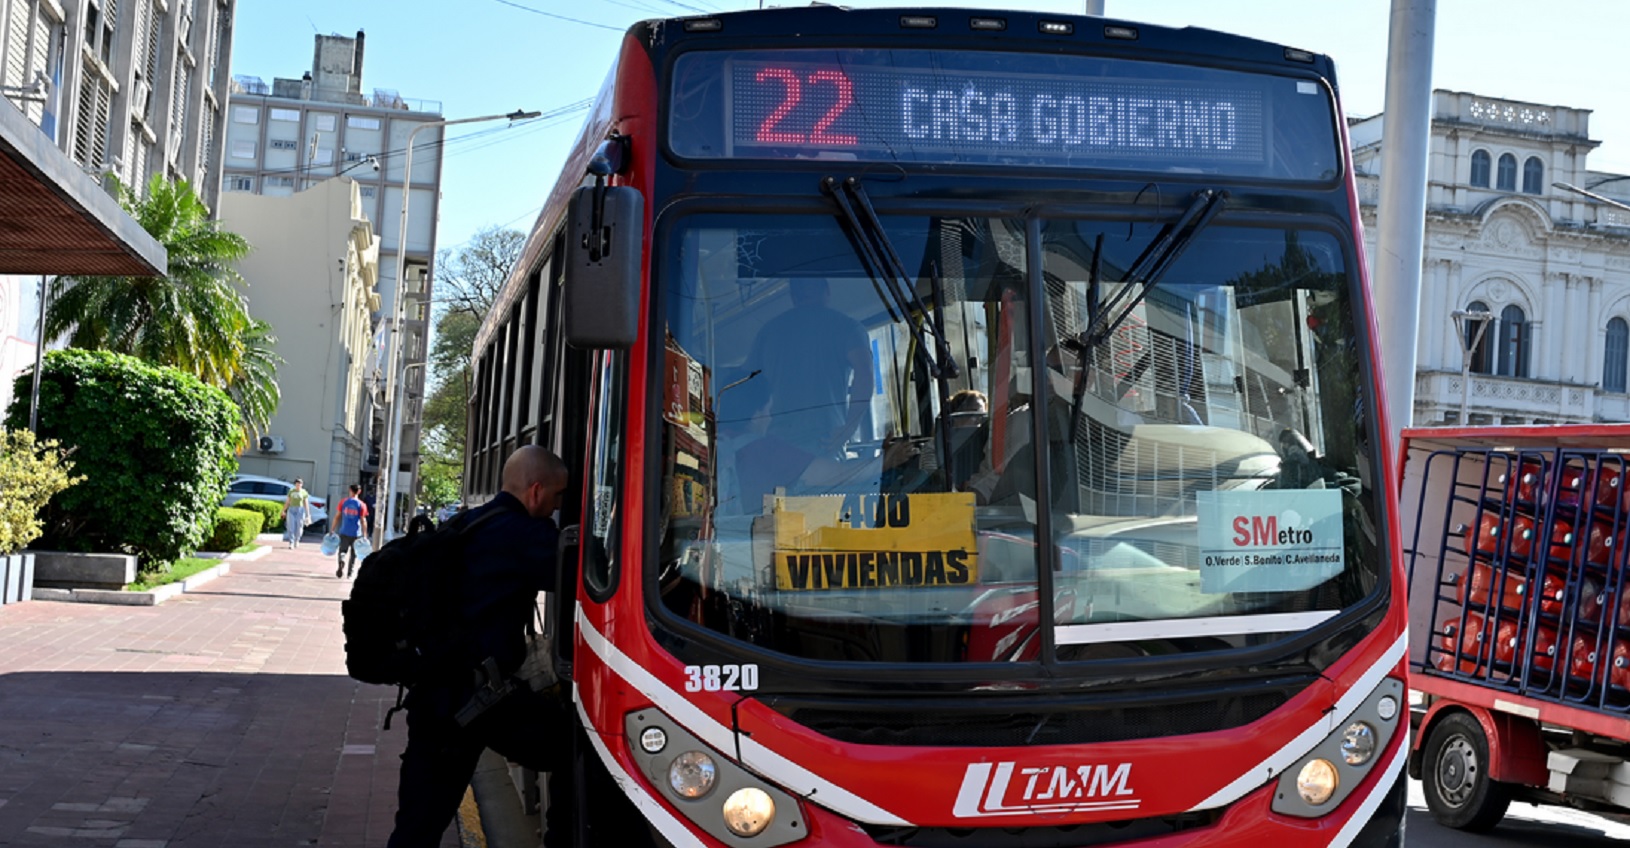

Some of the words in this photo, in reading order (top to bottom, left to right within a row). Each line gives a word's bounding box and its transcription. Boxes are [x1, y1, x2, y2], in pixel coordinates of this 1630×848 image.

[755, 67, 858, 146] 22
[901, 87, 1018, 143] CASA
[1032, 92, 1237, 150] GOBIERNO
[839, 494, 911, 529] 400
[1232, 515, 1313, 547] SMetro
[786, 549, 970, 590] VIVIENDAS
[684, 663, 759, 692] 3820
